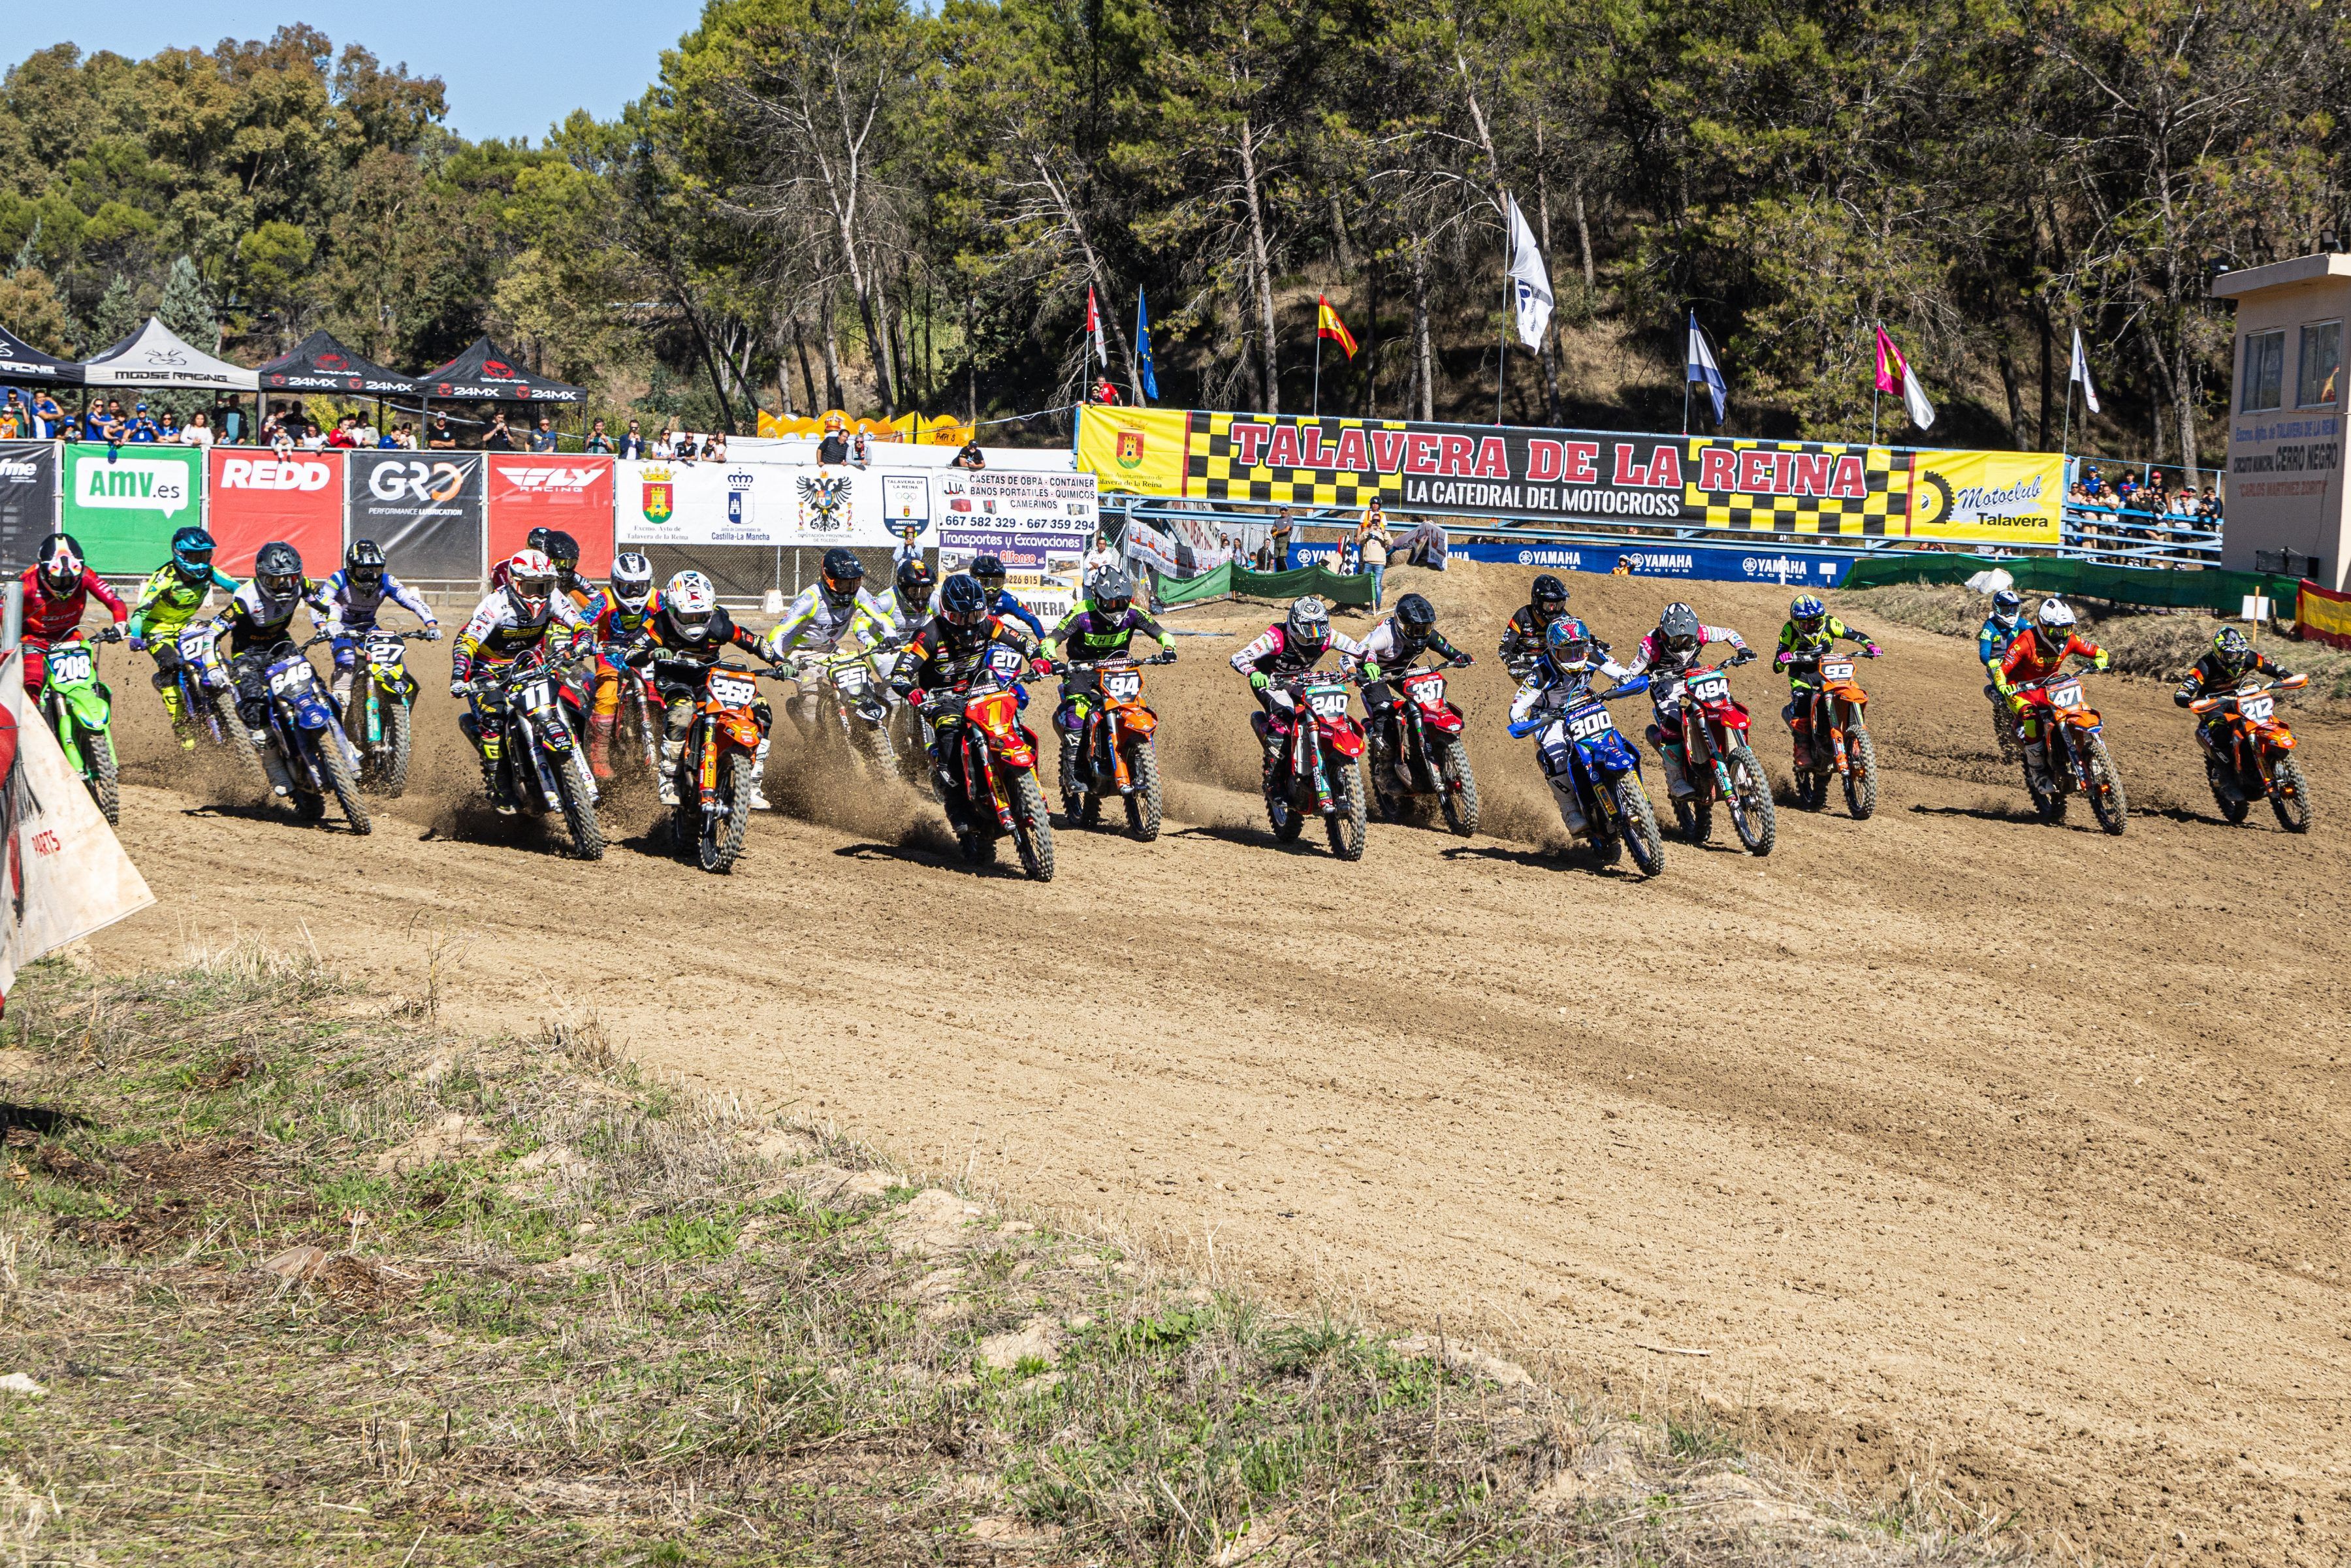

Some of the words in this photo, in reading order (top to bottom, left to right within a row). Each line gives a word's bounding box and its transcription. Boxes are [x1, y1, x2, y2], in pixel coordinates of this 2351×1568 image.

[115, 371, 170, 380] MOOSE
[173, 372, 227, 382] RACING
[289, 377, 338, 388] 24MX
[366, 381, 413, 392] 24MX
[454, 387, 500, 397] 24MX
[532, 389, 577, 400] 24MX
[1231, 423, 1510, 480] TALAVERA
[1526, 438, 1599, 485] DE
[1612, 443, 1683, 489] LA
[1699, 448, 1867, 499] REINA
[2276, 445, 2305, 472] CERRO
[2307, 442, 2338, 470] NEGRO
[221, 459, 330, 491] REDD
[496, 467, 606, 487] FLY
[970, 475, 1005, 485] CASETAS
[1008, 476, 1019, 485] DE
[1021, 476, 1043, 485] OBRA
[1049, 477, 1095, 487] CONTAINER
[944, 482, 965, 494] JJA
[1958, 475, 2042, 511] Motoclub
[1010, 500, 1058, 509] CAMERINOS
[1407, 480, 1428, 503] LA
[1432, 481, 1522, 507] CATEDRAL
[1530, 487, 1558, 510] DEL
[1562, 488, 1680, 517] MOTOCROSS
[368, 507, 418, 516] PERFORMANCE
[1977, 512, 2048, 528] Talavera
[946, 516, 966, 526] 667
[970, 517, 991, 526] 582
[995, 518, 1016, 528] 329
[1027, 519, 1047, 528] 667
[1050, 519, 1071, 530] 359
[1074, 520, 1095, 530] 294
[942, 532, 1002, 547] Transportes
[1005, 537, 1012, 549] y
[1015, 534, 1080, 548] Excavaciones
[1000, 550, 1036, 564] Alfonso
[1533, 551, 1580, 566] YAMAHA
[1644, 554, 1693, 568] YAMAHA
[1009, 575, 1022, 584] 226
[1025, 576, 1037, 584] 815
[372, 644, 406, 662] 27
[993, 651, 1021, 669] 217
[53, 656, 91, 684] 208
[835, 666, 867, 689] 351
[1825, 664, 1853, 679] 93
[270, 662, 312, 697] 646
[1111, 677, 1140, 696] 94
[522, 682, 550, 711] 11
[712, 679, 755, 705] 268
[971, 686, 1000, 696] RENTHAL
[1413, 679, 1443, 703] 337
[1695, 679, 1729, 701] 494
[2053, 686, 2082, 707] 471
[986, 700, 1002, 726] 1
[1311, 695, 1348, 715] 240
[1569, 704, 1601, 720] E.CASTRO
[2242, 697, 2273, 720] 212
[1569, 711, 1612, 742] 300
[31, 830, 61, 859] PARTS
